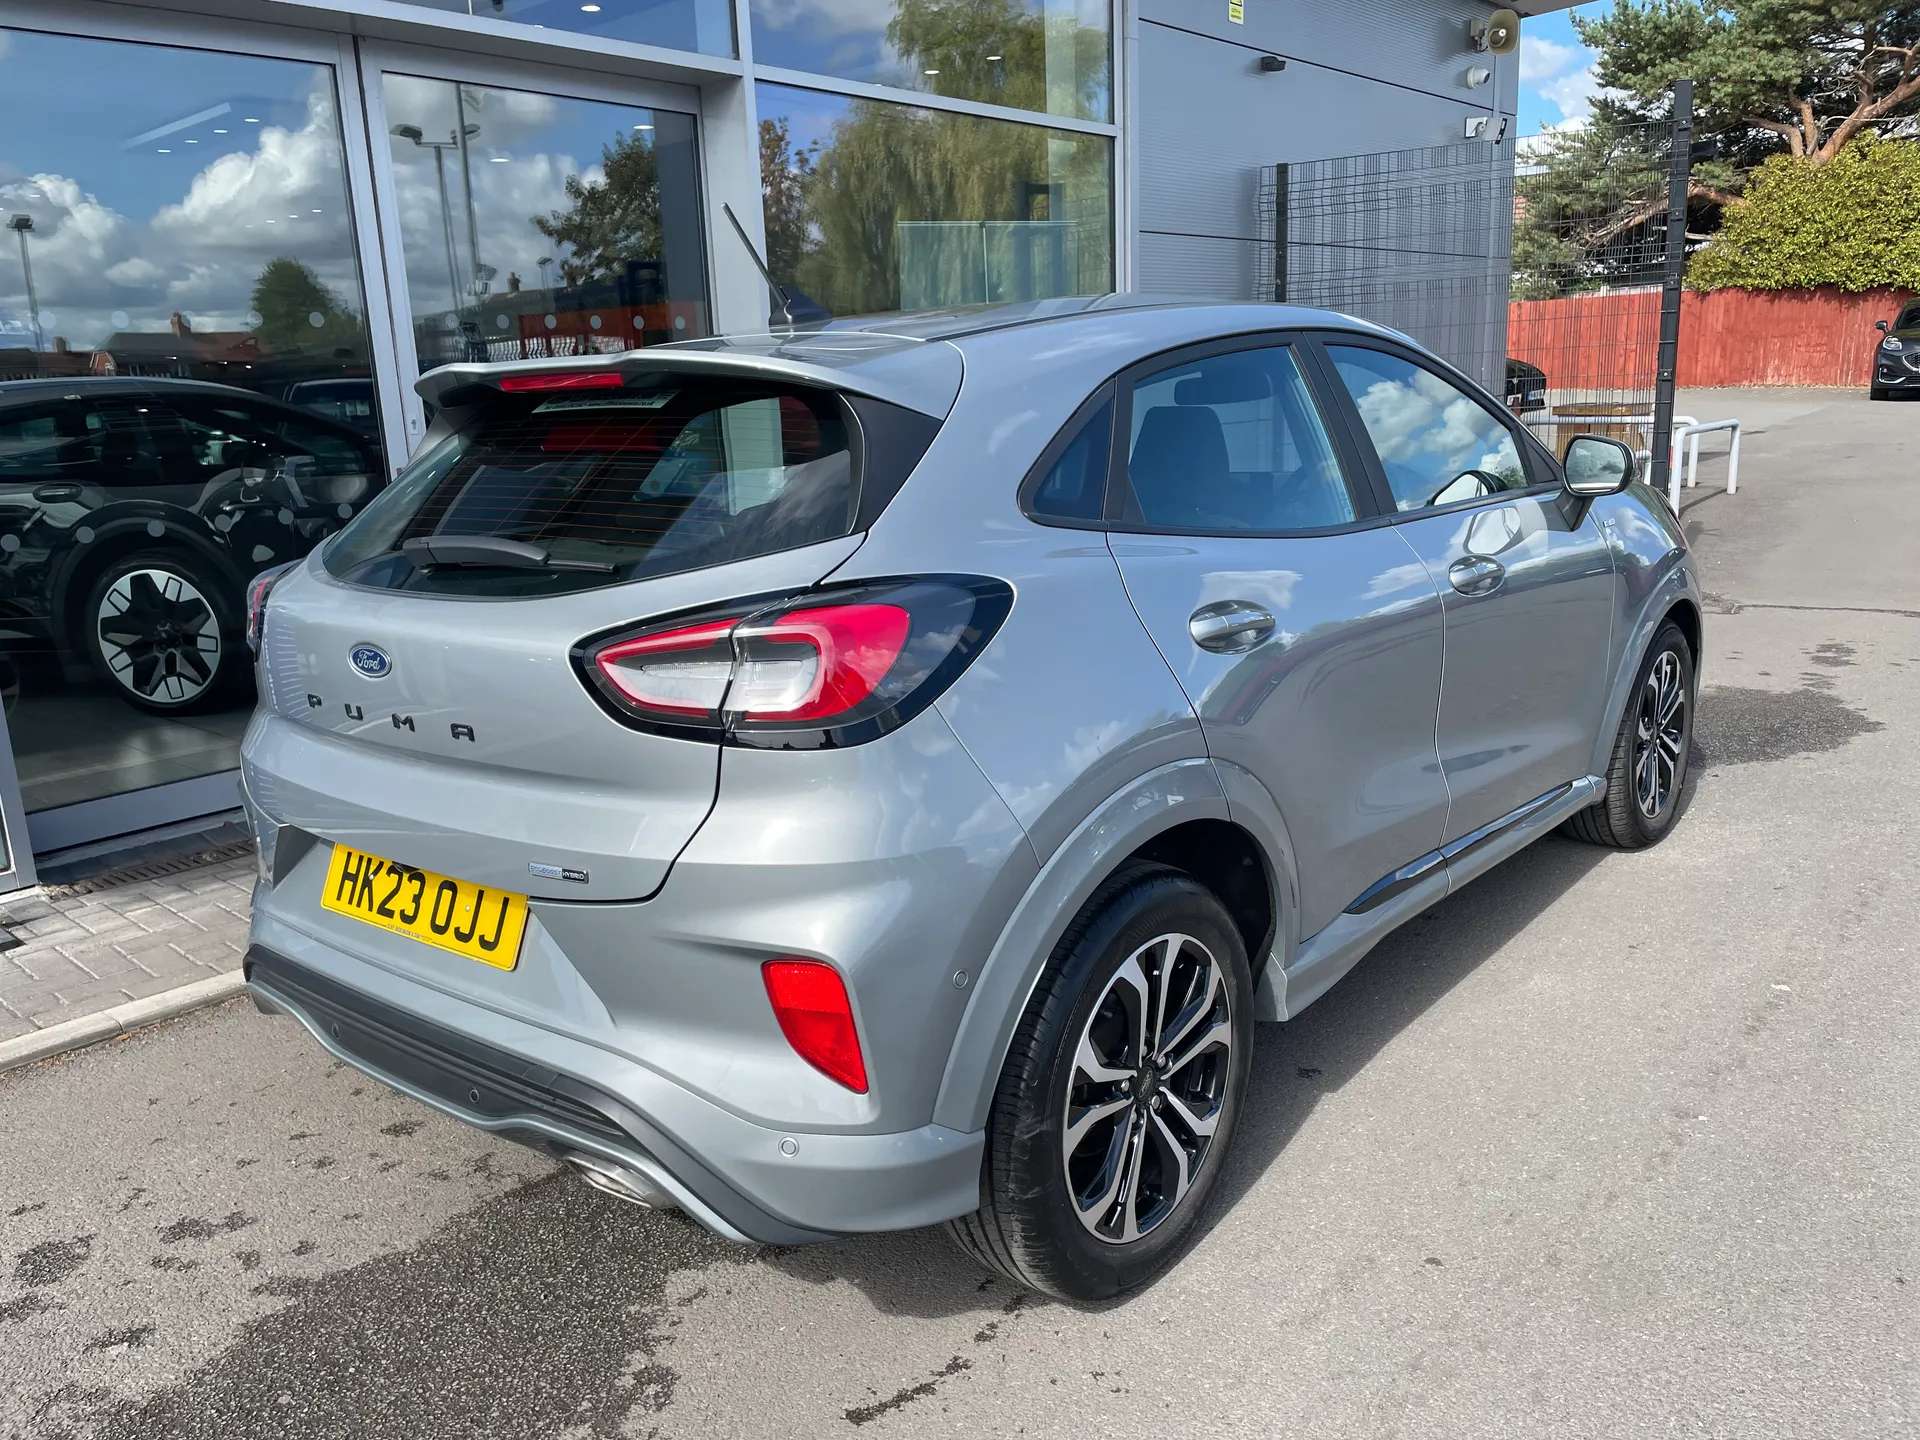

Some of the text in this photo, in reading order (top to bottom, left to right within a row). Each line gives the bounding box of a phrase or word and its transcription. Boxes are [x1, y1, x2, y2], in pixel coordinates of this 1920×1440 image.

[307, 693, 475, 742] PUMA
[335, 851, 510, 952] HK23 OJJ
